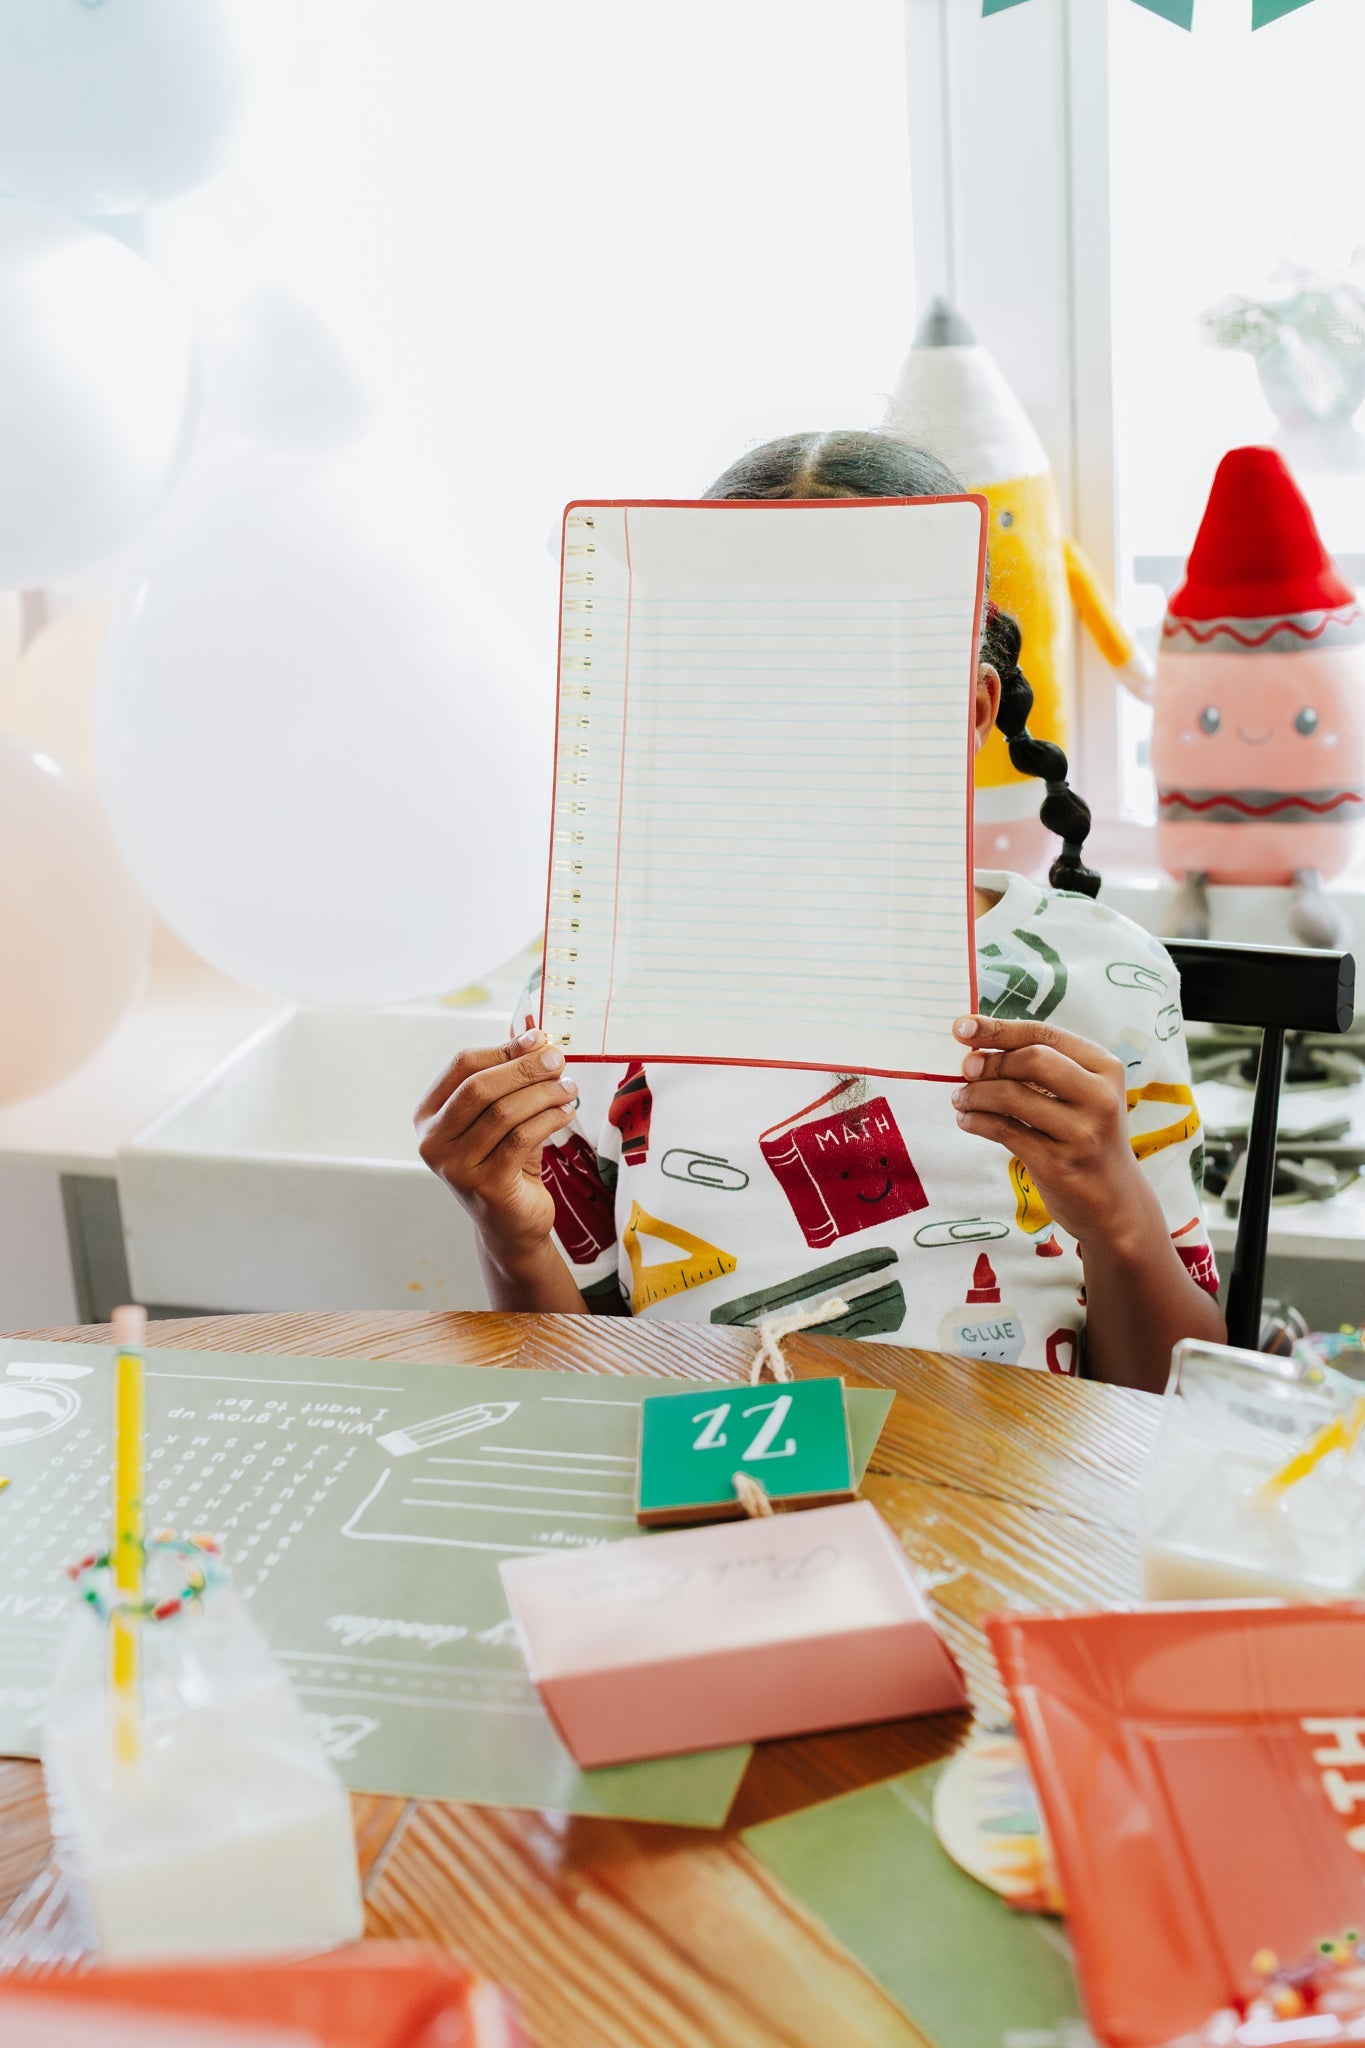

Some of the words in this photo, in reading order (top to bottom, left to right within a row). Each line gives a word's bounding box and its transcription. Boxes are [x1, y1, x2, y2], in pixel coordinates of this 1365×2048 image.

[814, 1113, 890, 1152] MATH
[961, 1322, 1016, 1342] GLUE
[167, 1407, 197, 1420] up
[264, 1400, 288, 1414] to
[300, 1402, 362, 1416] want
[206, 1411, 272, 1424] grow
[306, 1417, 374, 1436] When
